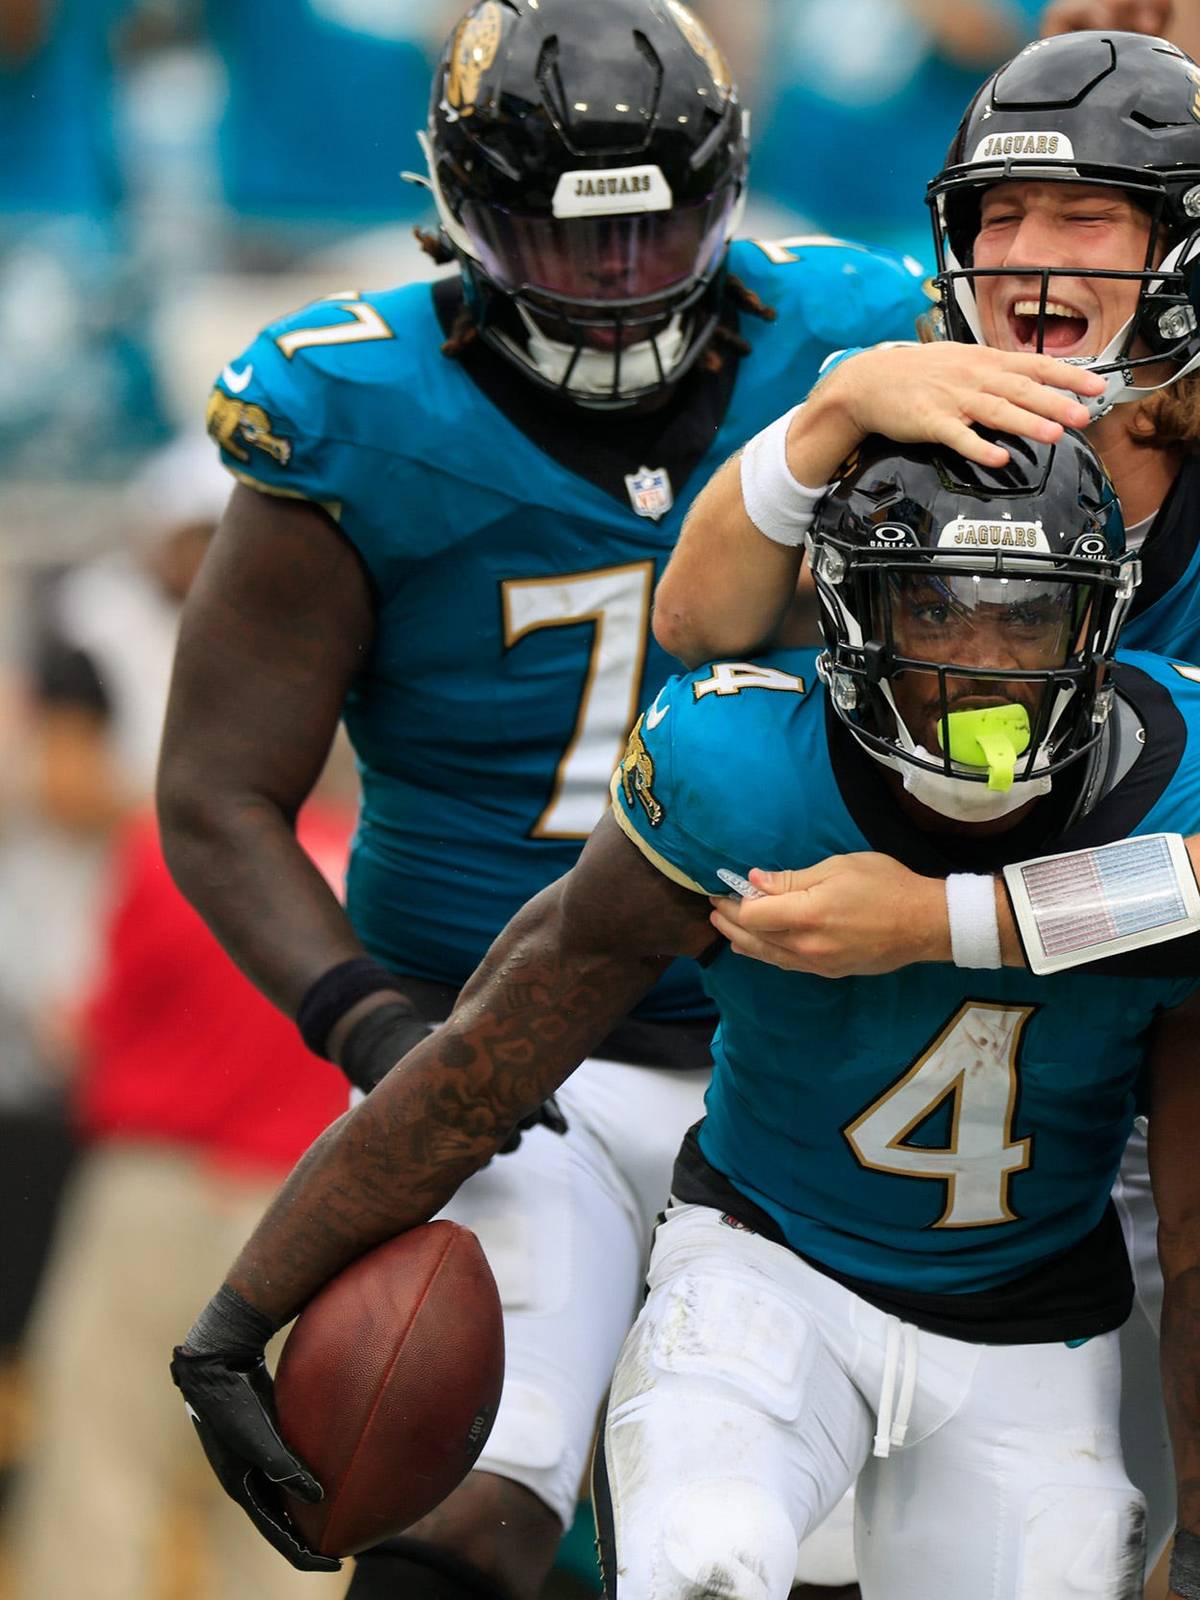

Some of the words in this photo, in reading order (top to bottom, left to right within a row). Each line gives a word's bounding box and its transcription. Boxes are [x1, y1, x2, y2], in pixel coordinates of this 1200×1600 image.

[984, 135, 1060, 157] JAGUARS
[575, 175, 651, 196] JAGUARS
[954, 524, 1038, 547] JAGUARS
[841, 998, 1035, 1231] 4
